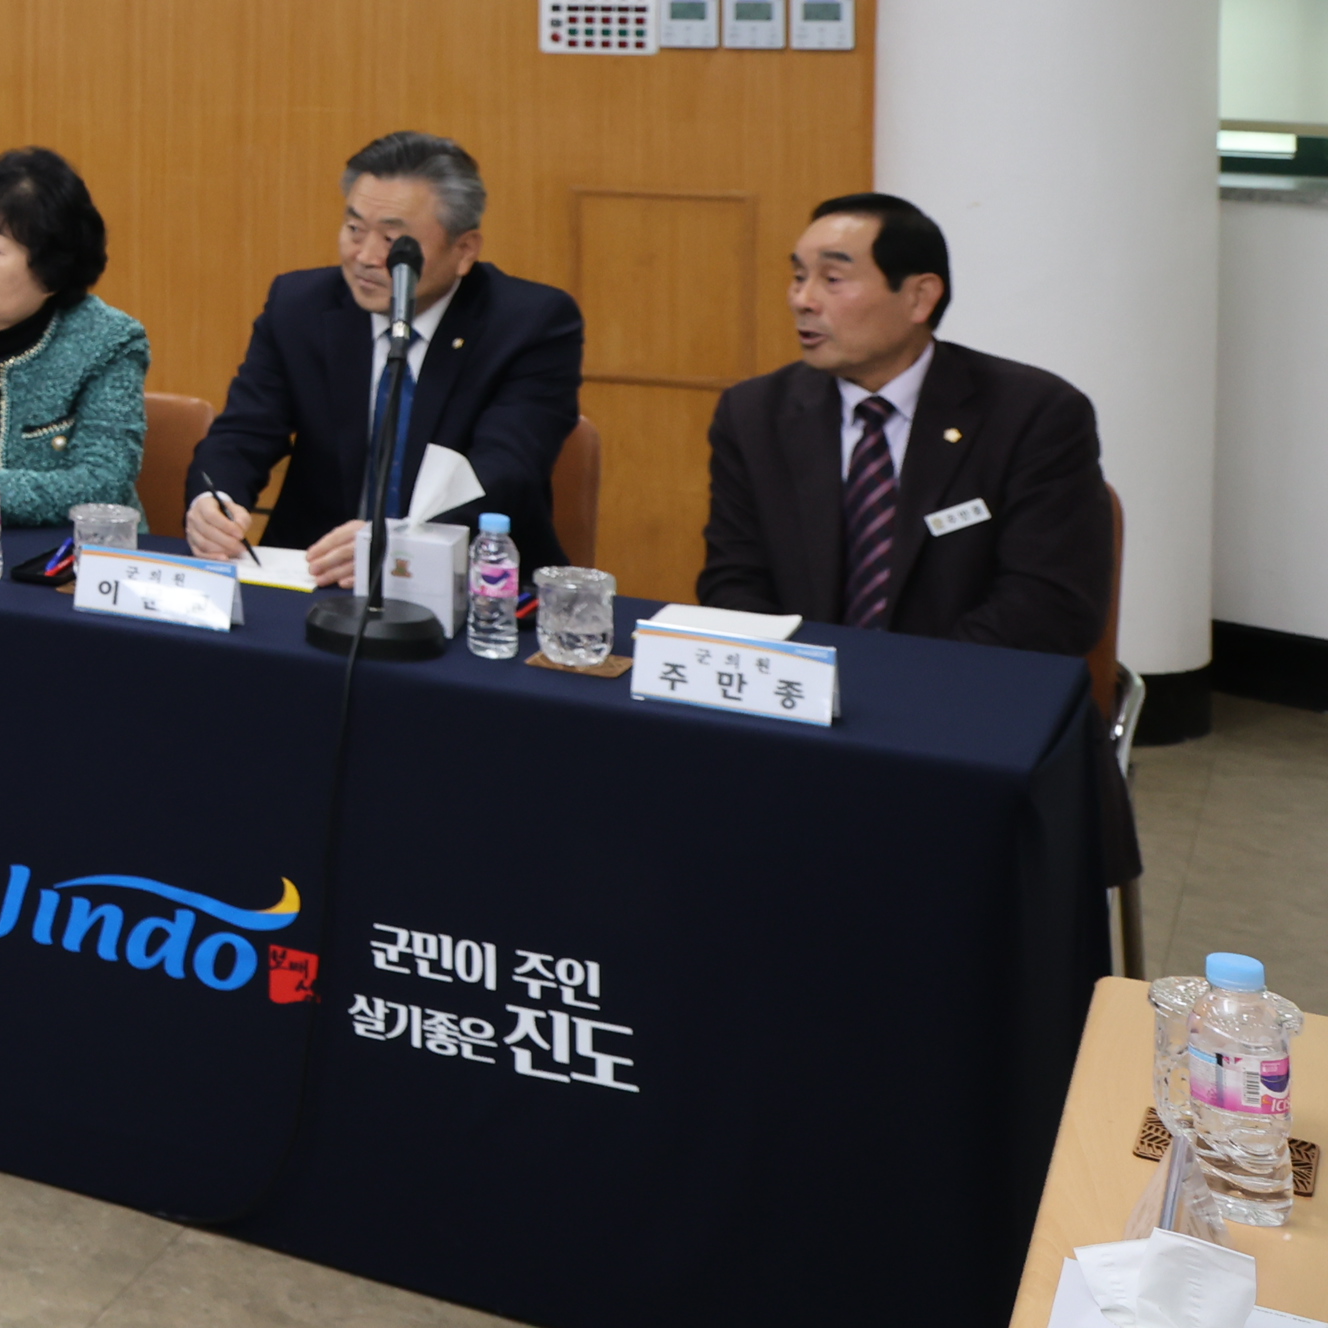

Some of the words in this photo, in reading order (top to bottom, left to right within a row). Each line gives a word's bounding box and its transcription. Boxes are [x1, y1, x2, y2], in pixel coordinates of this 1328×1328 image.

[659, 661, 805, 710] 주만종
[695, 648, 771, 675] 군의원
[370, 922, 497, 991] 군민이
[512, 948, 601, 1011] 주인
[347, 993, 498, 1065] 살기좋은
[503, 1003, 640, 1094] 진도
